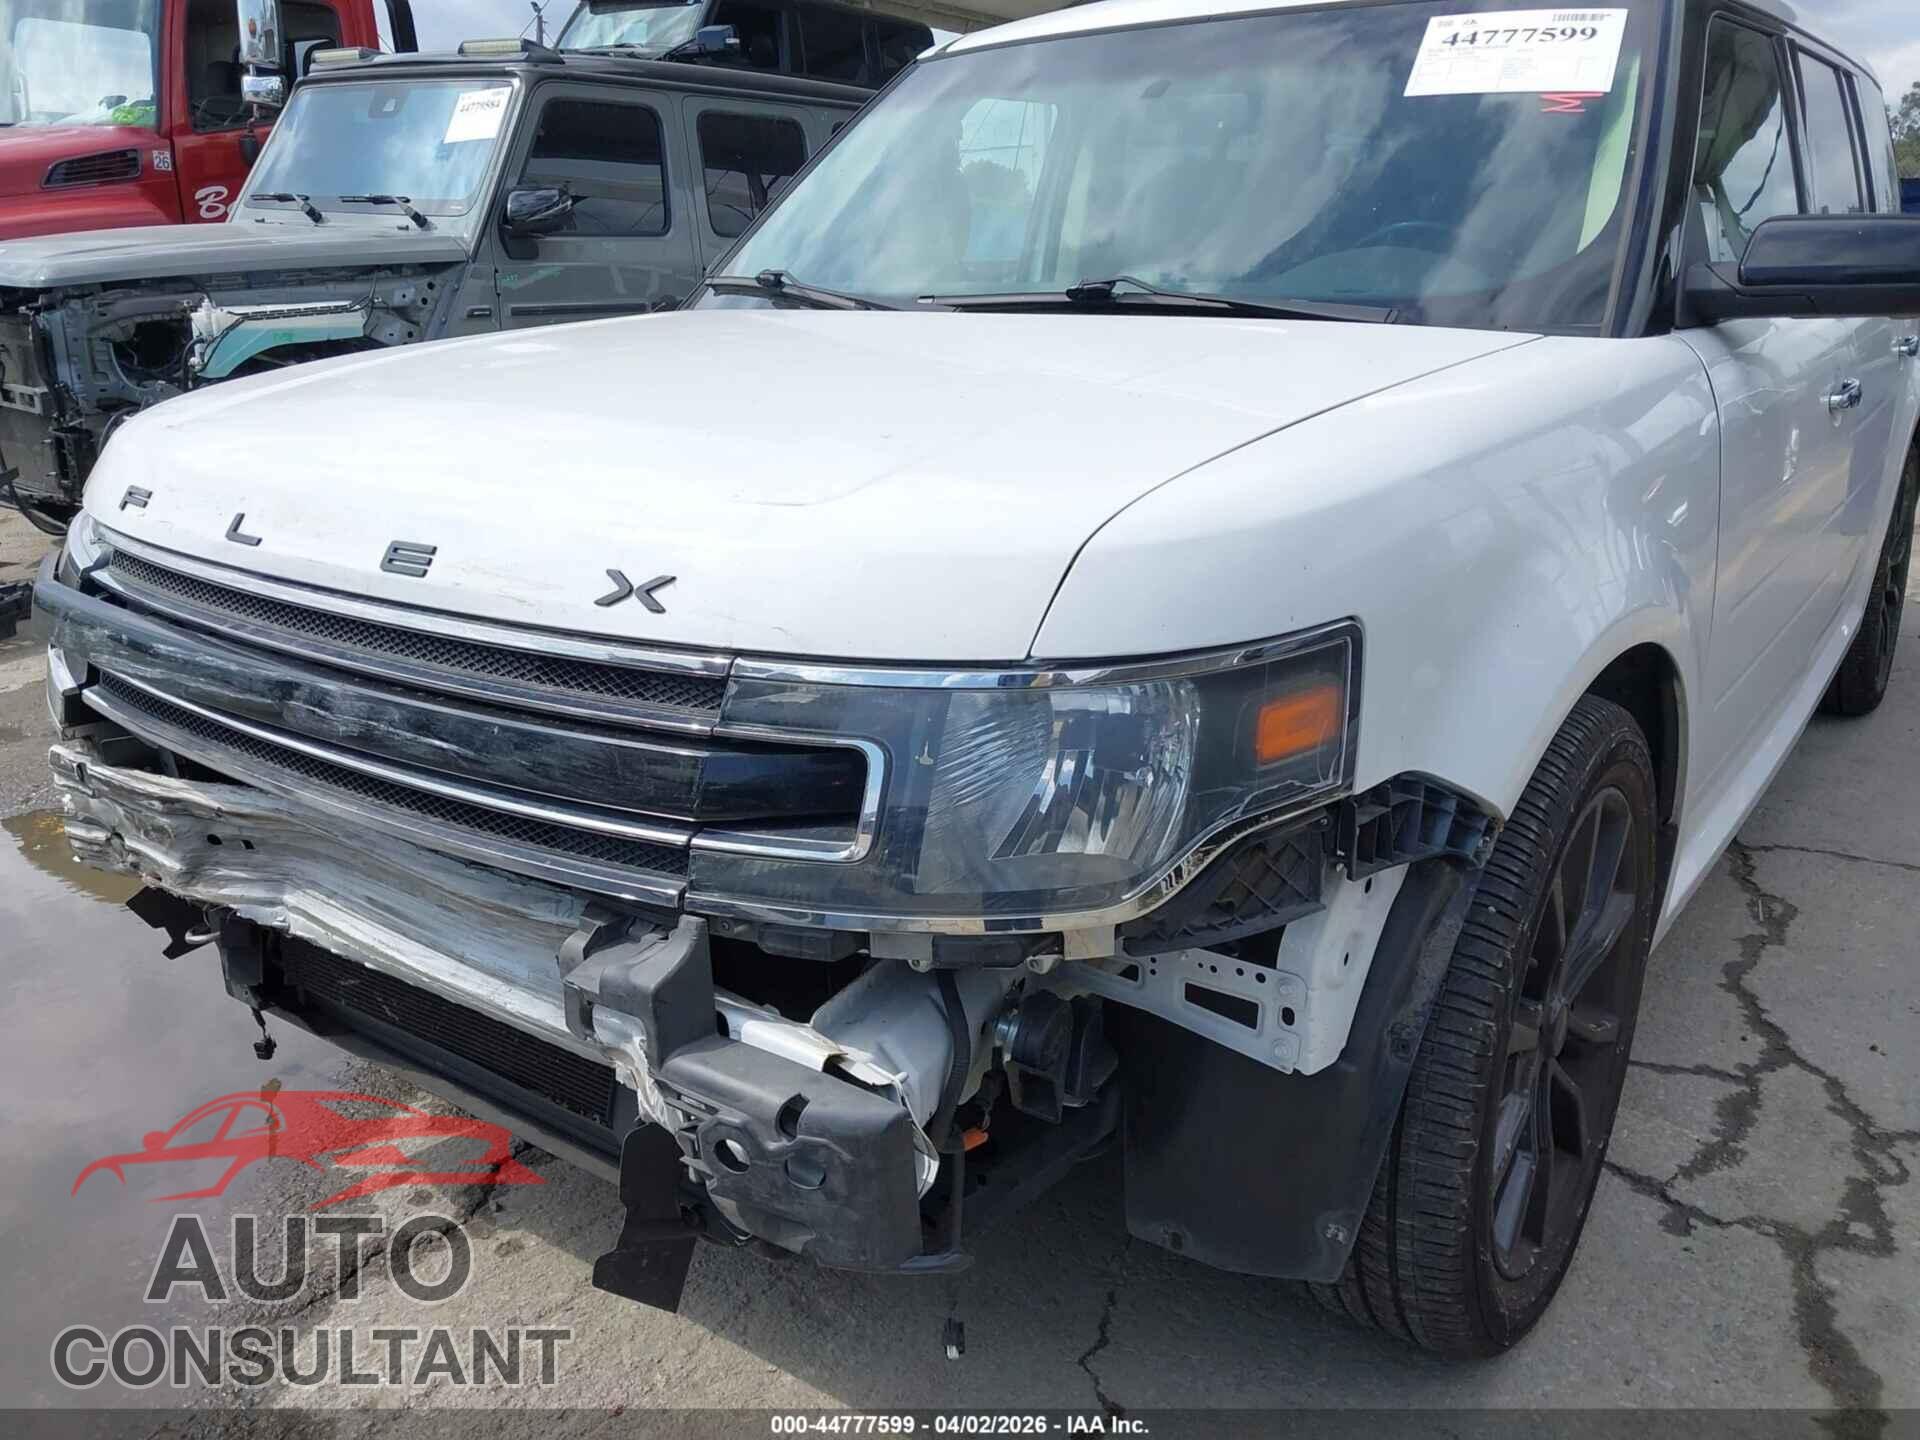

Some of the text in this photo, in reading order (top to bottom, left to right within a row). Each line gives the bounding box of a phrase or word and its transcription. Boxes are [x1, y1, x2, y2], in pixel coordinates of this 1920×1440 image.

[1442, 26, 1598, 46] 44777599
[155, 155, 170, 169] 26
[118, 485, 677, 614] FLEX
